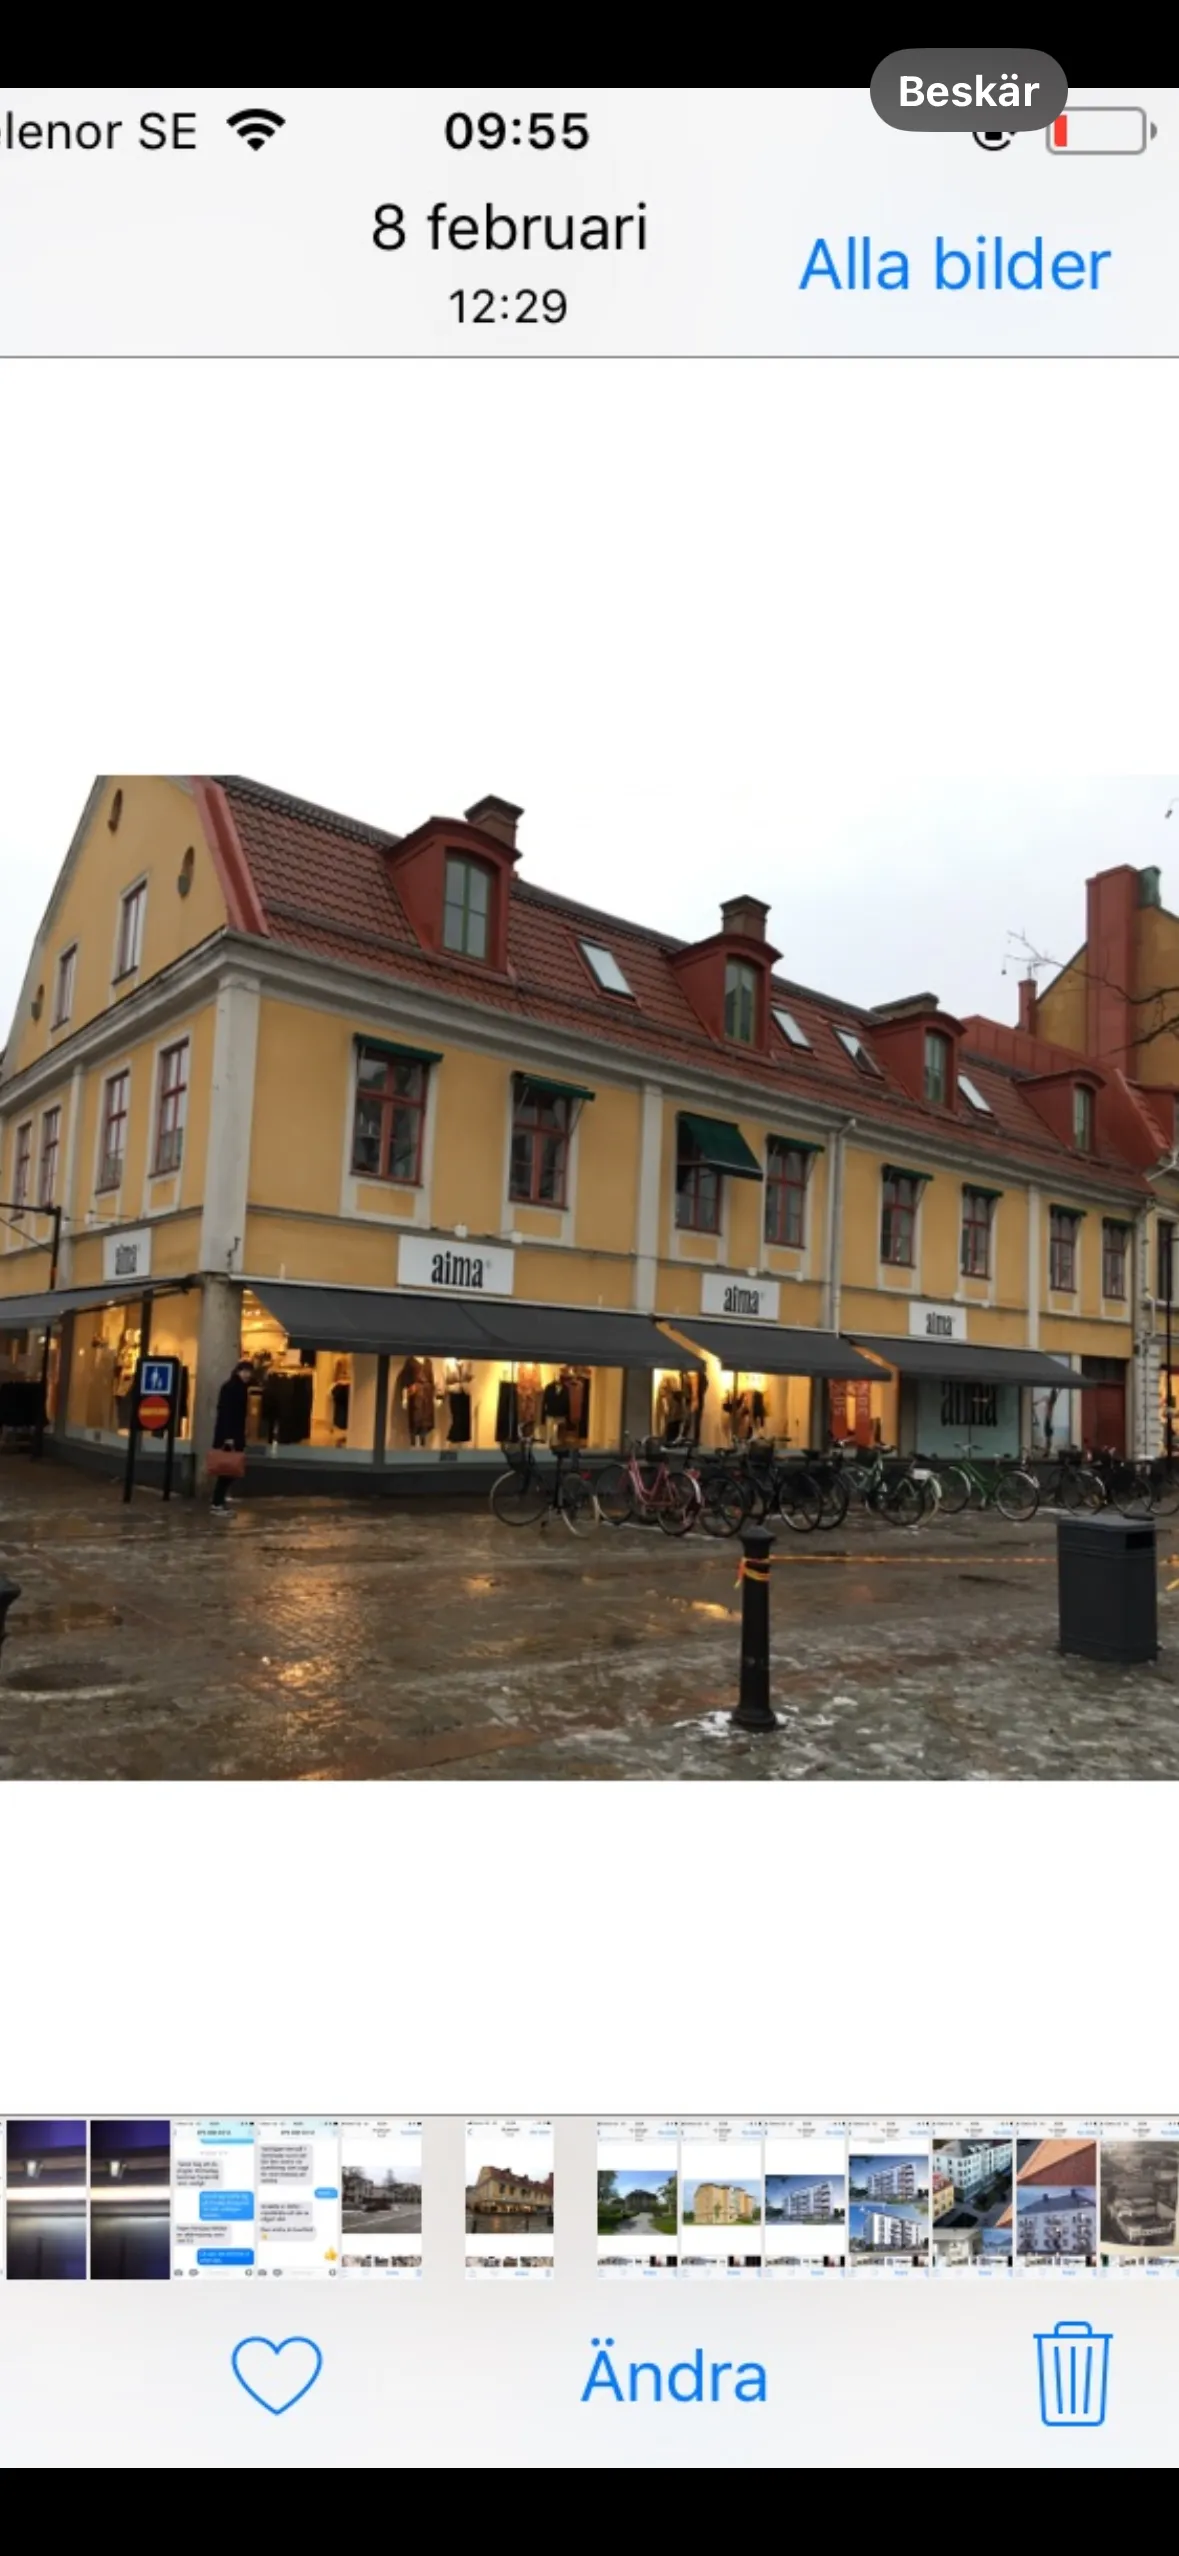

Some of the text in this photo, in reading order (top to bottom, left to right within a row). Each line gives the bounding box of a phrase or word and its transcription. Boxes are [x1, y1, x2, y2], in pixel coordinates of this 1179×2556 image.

[899, 73, 1040, 108] Beskär
[0, 110, 197, 150] lenor SE
[444, 111, 590, 150] 09:55
[372, 200, 647, 252] 8 februari
[799, 234, 1113, 291] Alla bilder
[449, 287, 568, 325] 12:29
[431, 1250, 484, 1289] aima
[580, 2336, 767, 2403] Ändra
